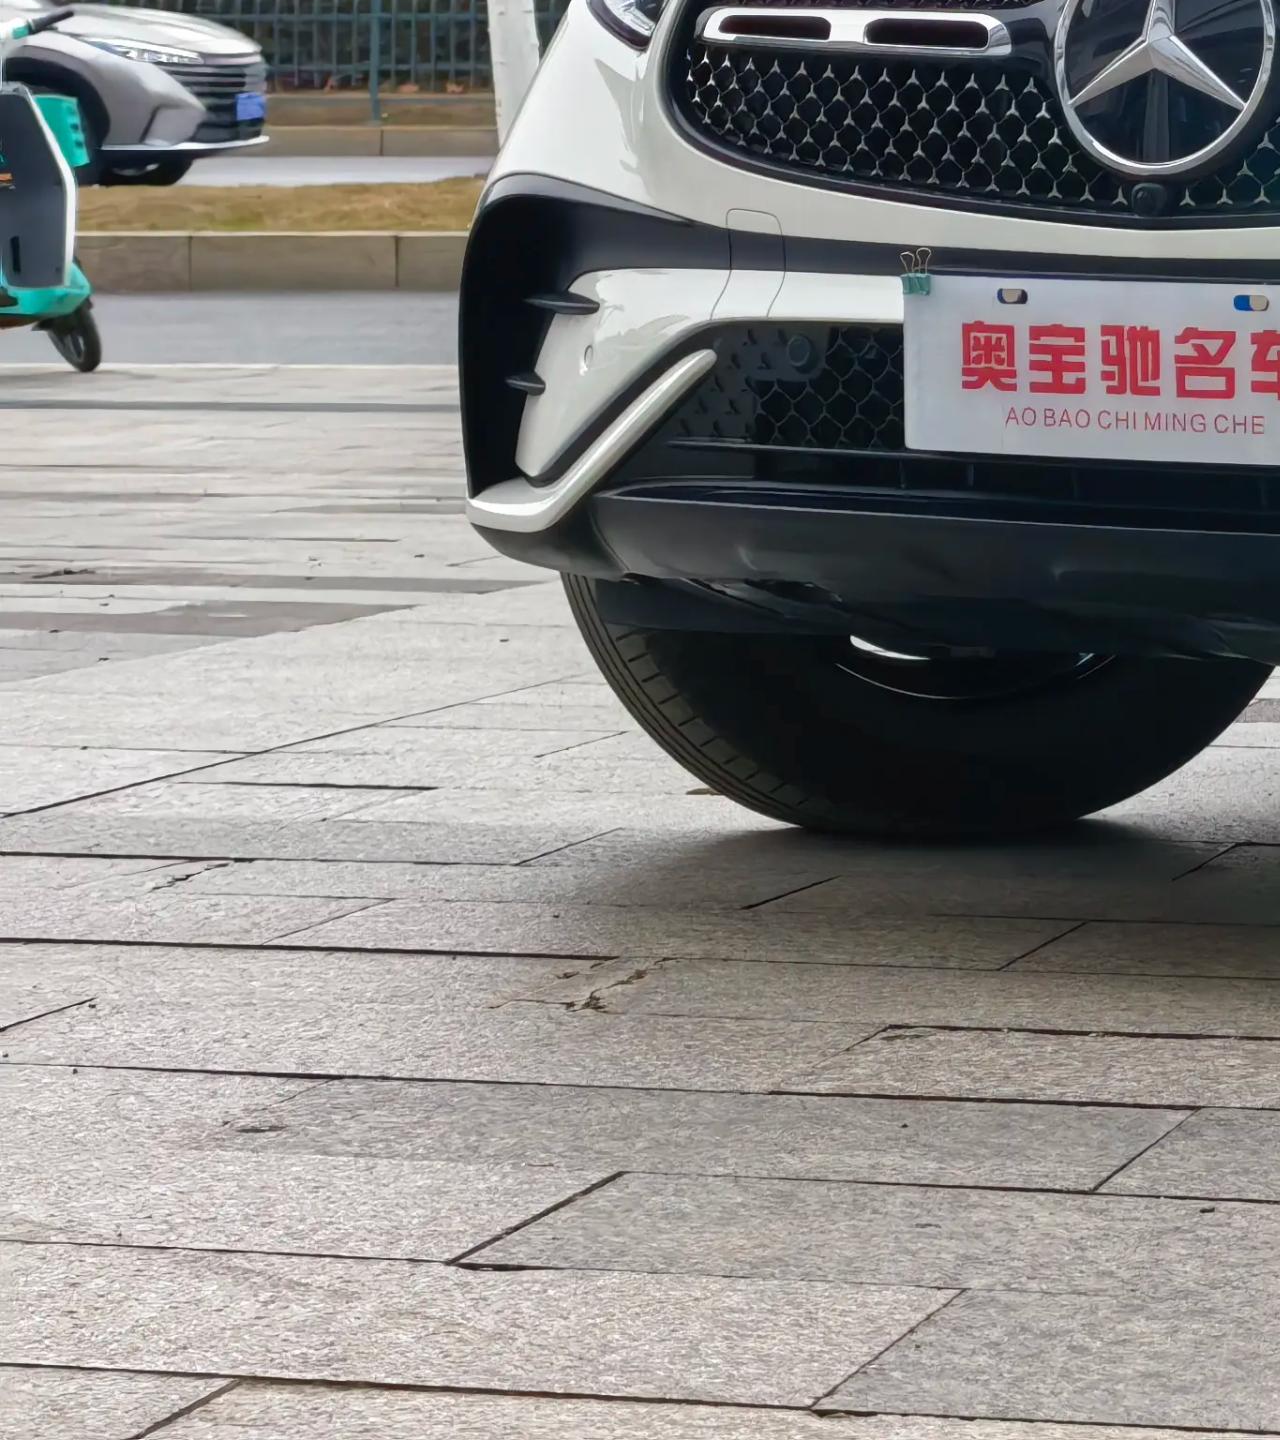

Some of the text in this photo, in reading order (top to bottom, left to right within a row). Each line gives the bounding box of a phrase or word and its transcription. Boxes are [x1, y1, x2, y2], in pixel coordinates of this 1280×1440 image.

[1005, 407, 1266, 436] AO BAO CHI MING CHE
